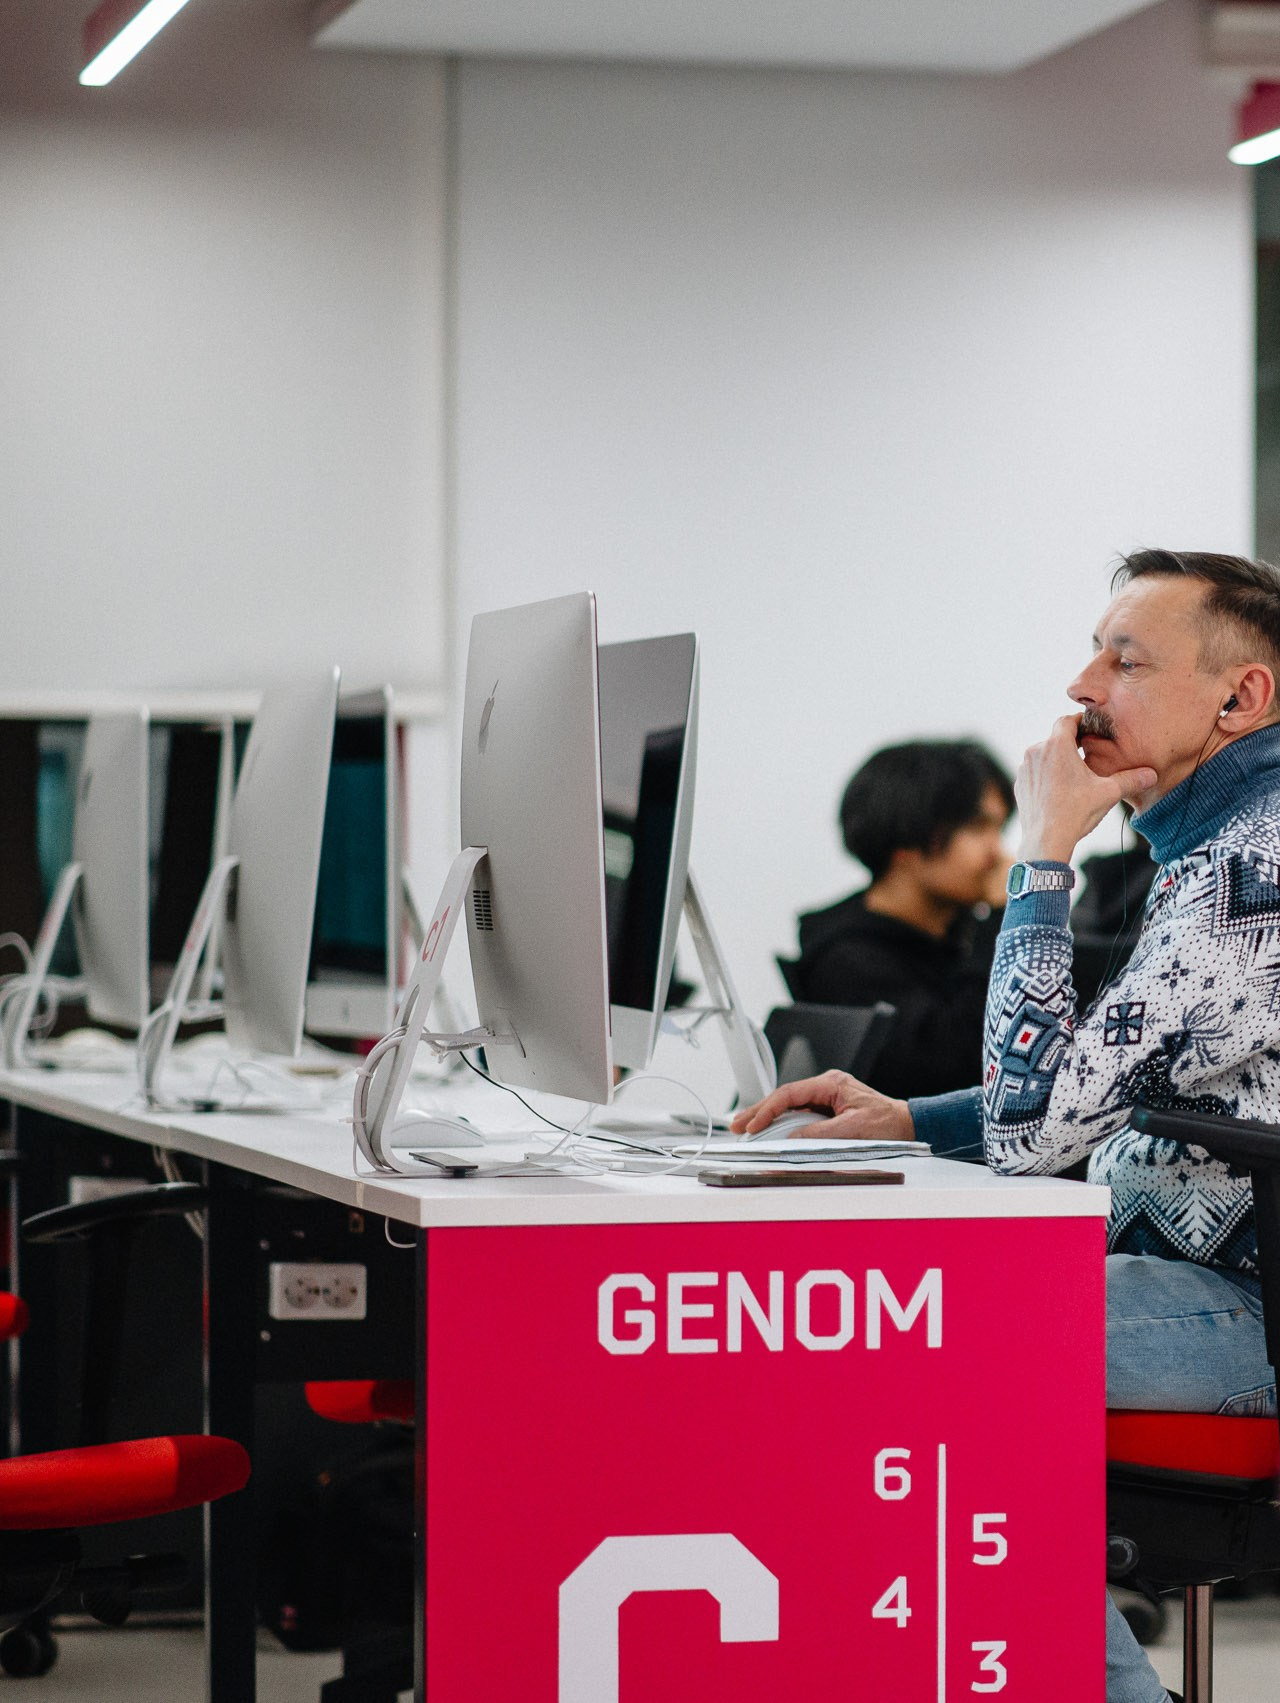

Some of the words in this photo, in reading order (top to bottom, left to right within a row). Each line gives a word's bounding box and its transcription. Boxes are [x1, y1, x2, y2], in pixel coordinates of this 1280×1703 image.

[422, 905, 450, 962] C1
[597, 1267, 944, 1356] GENOM
[874, 1447, 912, 1501] 6
[972, 1513, 1009, 1567] 5
[872, 1576, 913, 1629] 4
[971, 1640, 1008, 1694] 3
